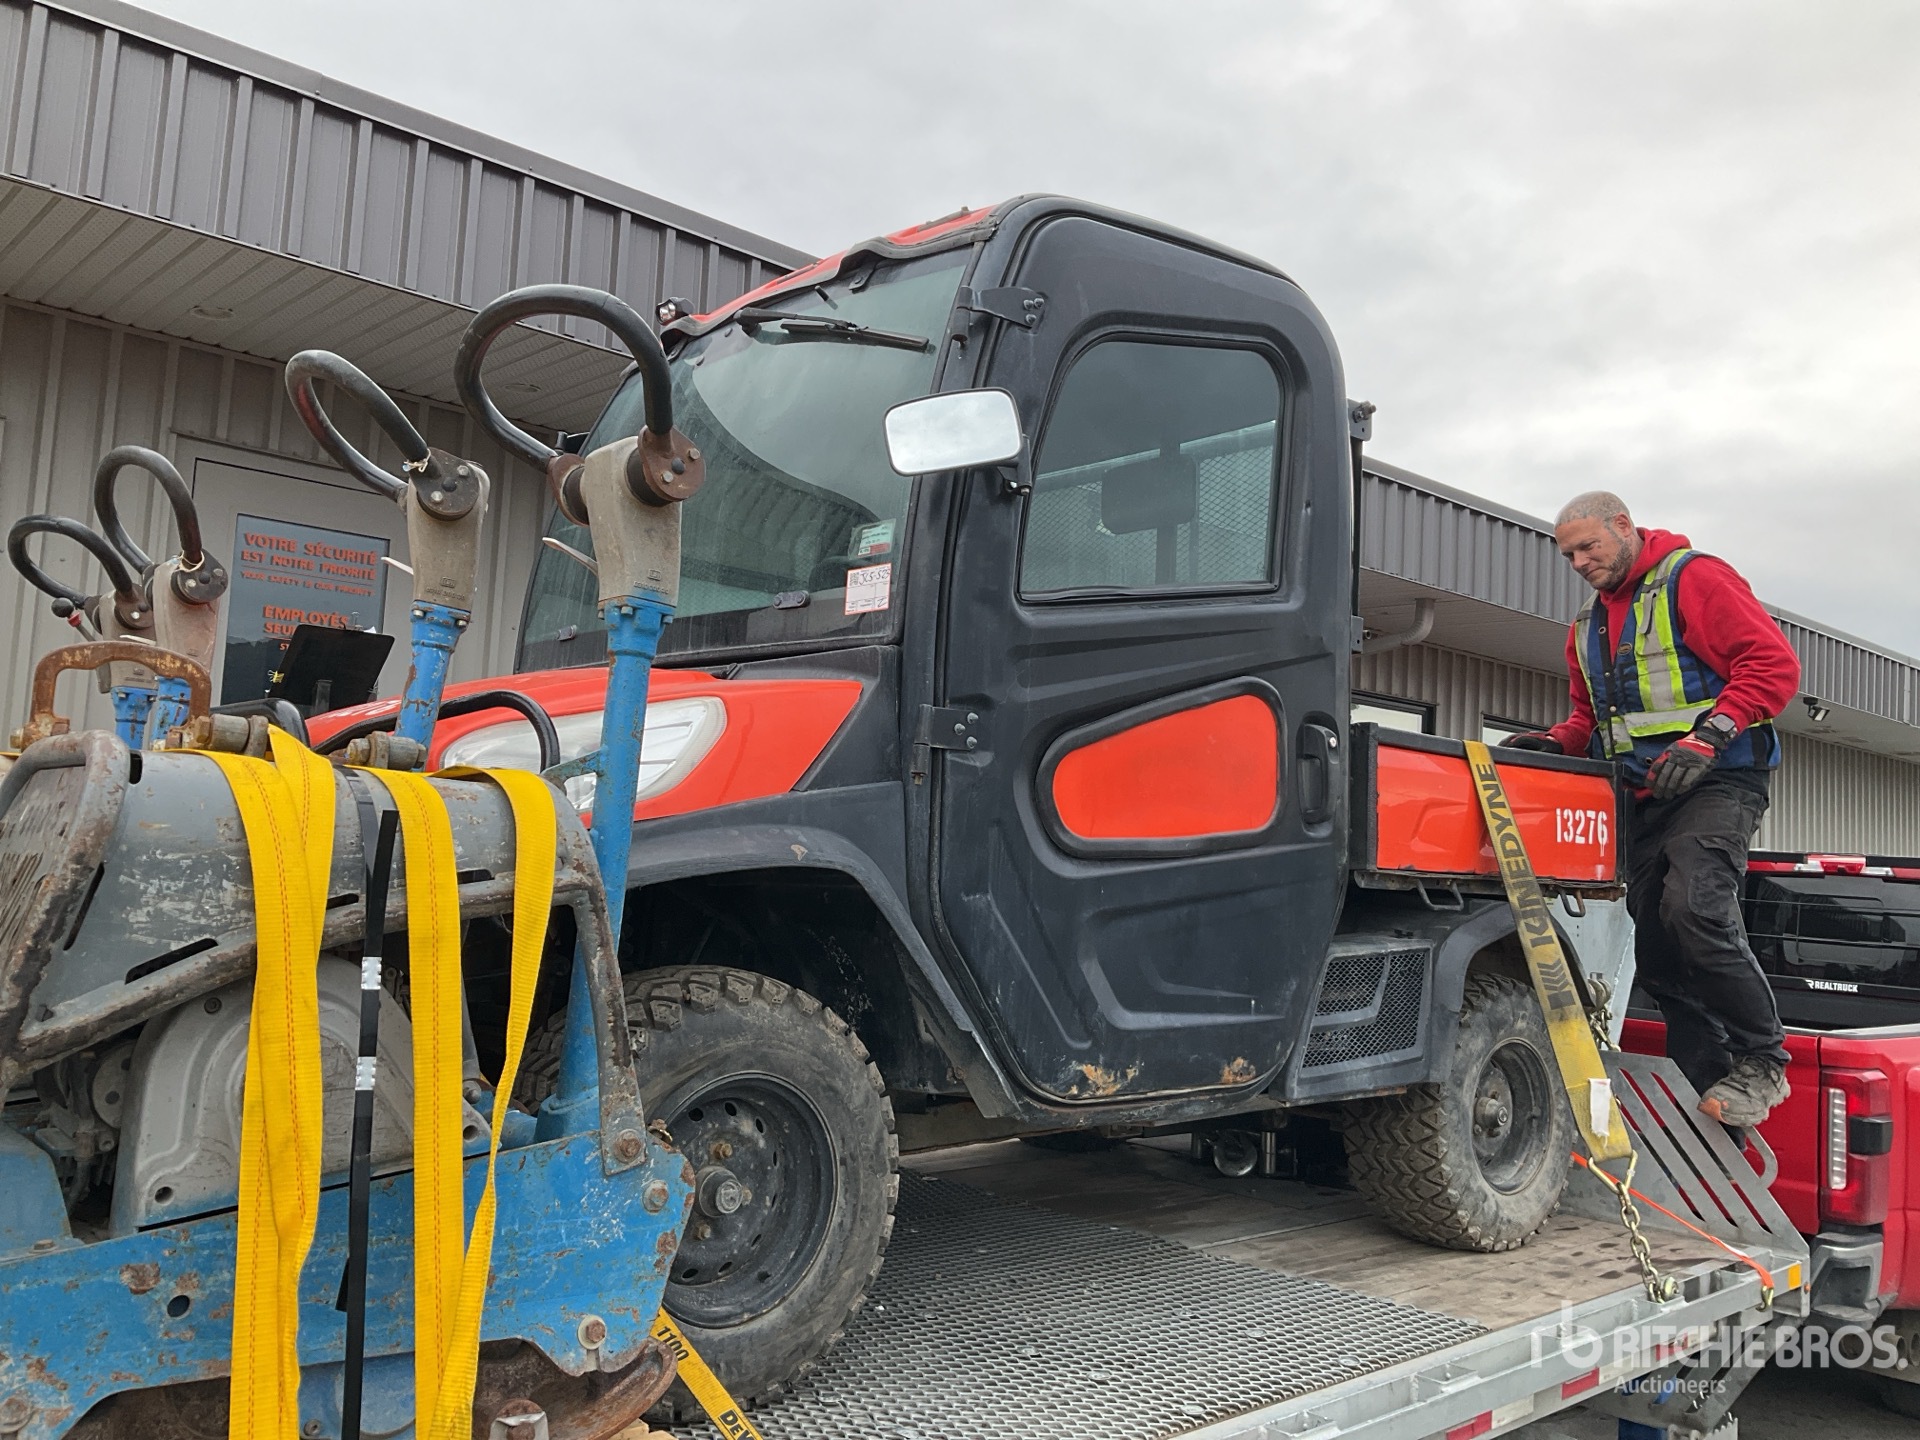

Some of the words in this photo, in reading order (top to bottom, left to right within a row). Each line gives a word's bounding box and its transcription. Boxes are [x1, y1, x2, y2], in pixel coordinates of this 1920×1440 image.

[241, 550, 267, 564] EST
[271, 554, 315, 571] NOTRE
[319, 562, 377, 580] PRIORITÉ
[243, 532, 297, 552] VOTRE
[304, 541, 377, 566] SÉCURITÉ
[263, 604, 350, 629] EMPLOYÉS
[1556, 808, 1608, 845] 13276
[1477, 763, 1554, 949] KINEDYNE
[1814, 980, 1859, 993] REALTRUCK
